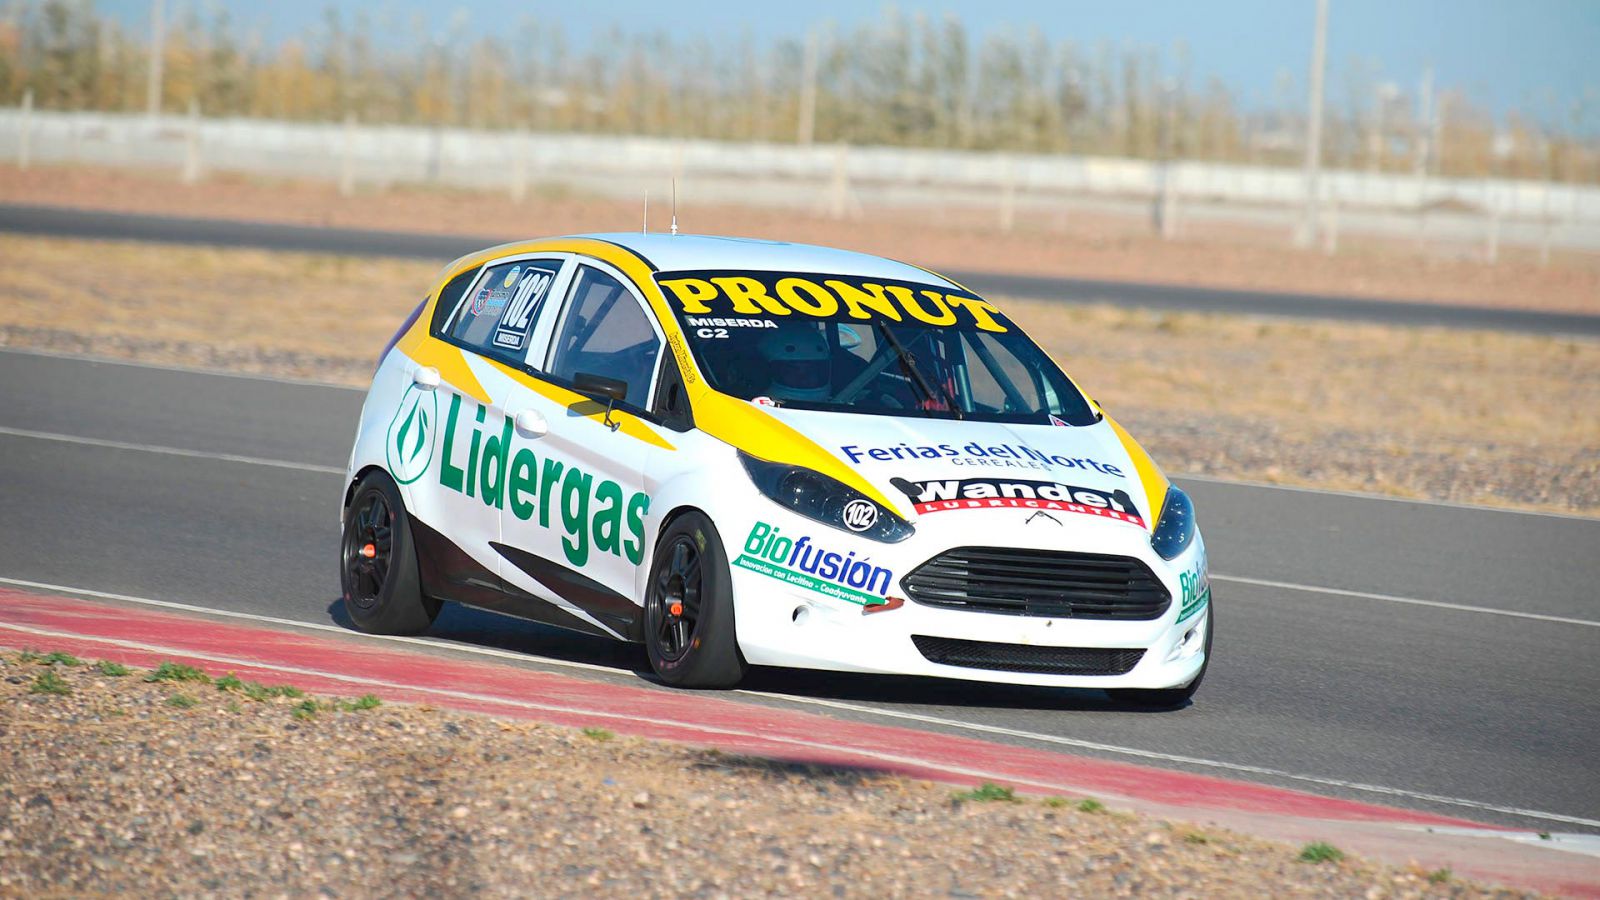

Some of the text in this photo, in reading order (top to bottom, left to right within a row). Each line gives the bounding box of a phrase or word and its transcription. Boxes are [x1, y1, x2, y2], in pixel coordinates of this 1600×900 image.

[502, 273, 550, 329] 102
[658, 276, 1008, 333] PRONUT
[688, 317, 778, 329] MISERDA
[697, 328, 730, 339] C2
[841, 442, 1126, 478] Ferias del Norte
[952, 457, 1052, 472] CEREALES
[440, 393, 650, 567] Lidergas
[847, 503, 872, 525] 102
[924, 500, 1141, 523] LUBRICANTES
[744, 521, 893, 596] Biofusión
[773, 569, 786, 579] con
